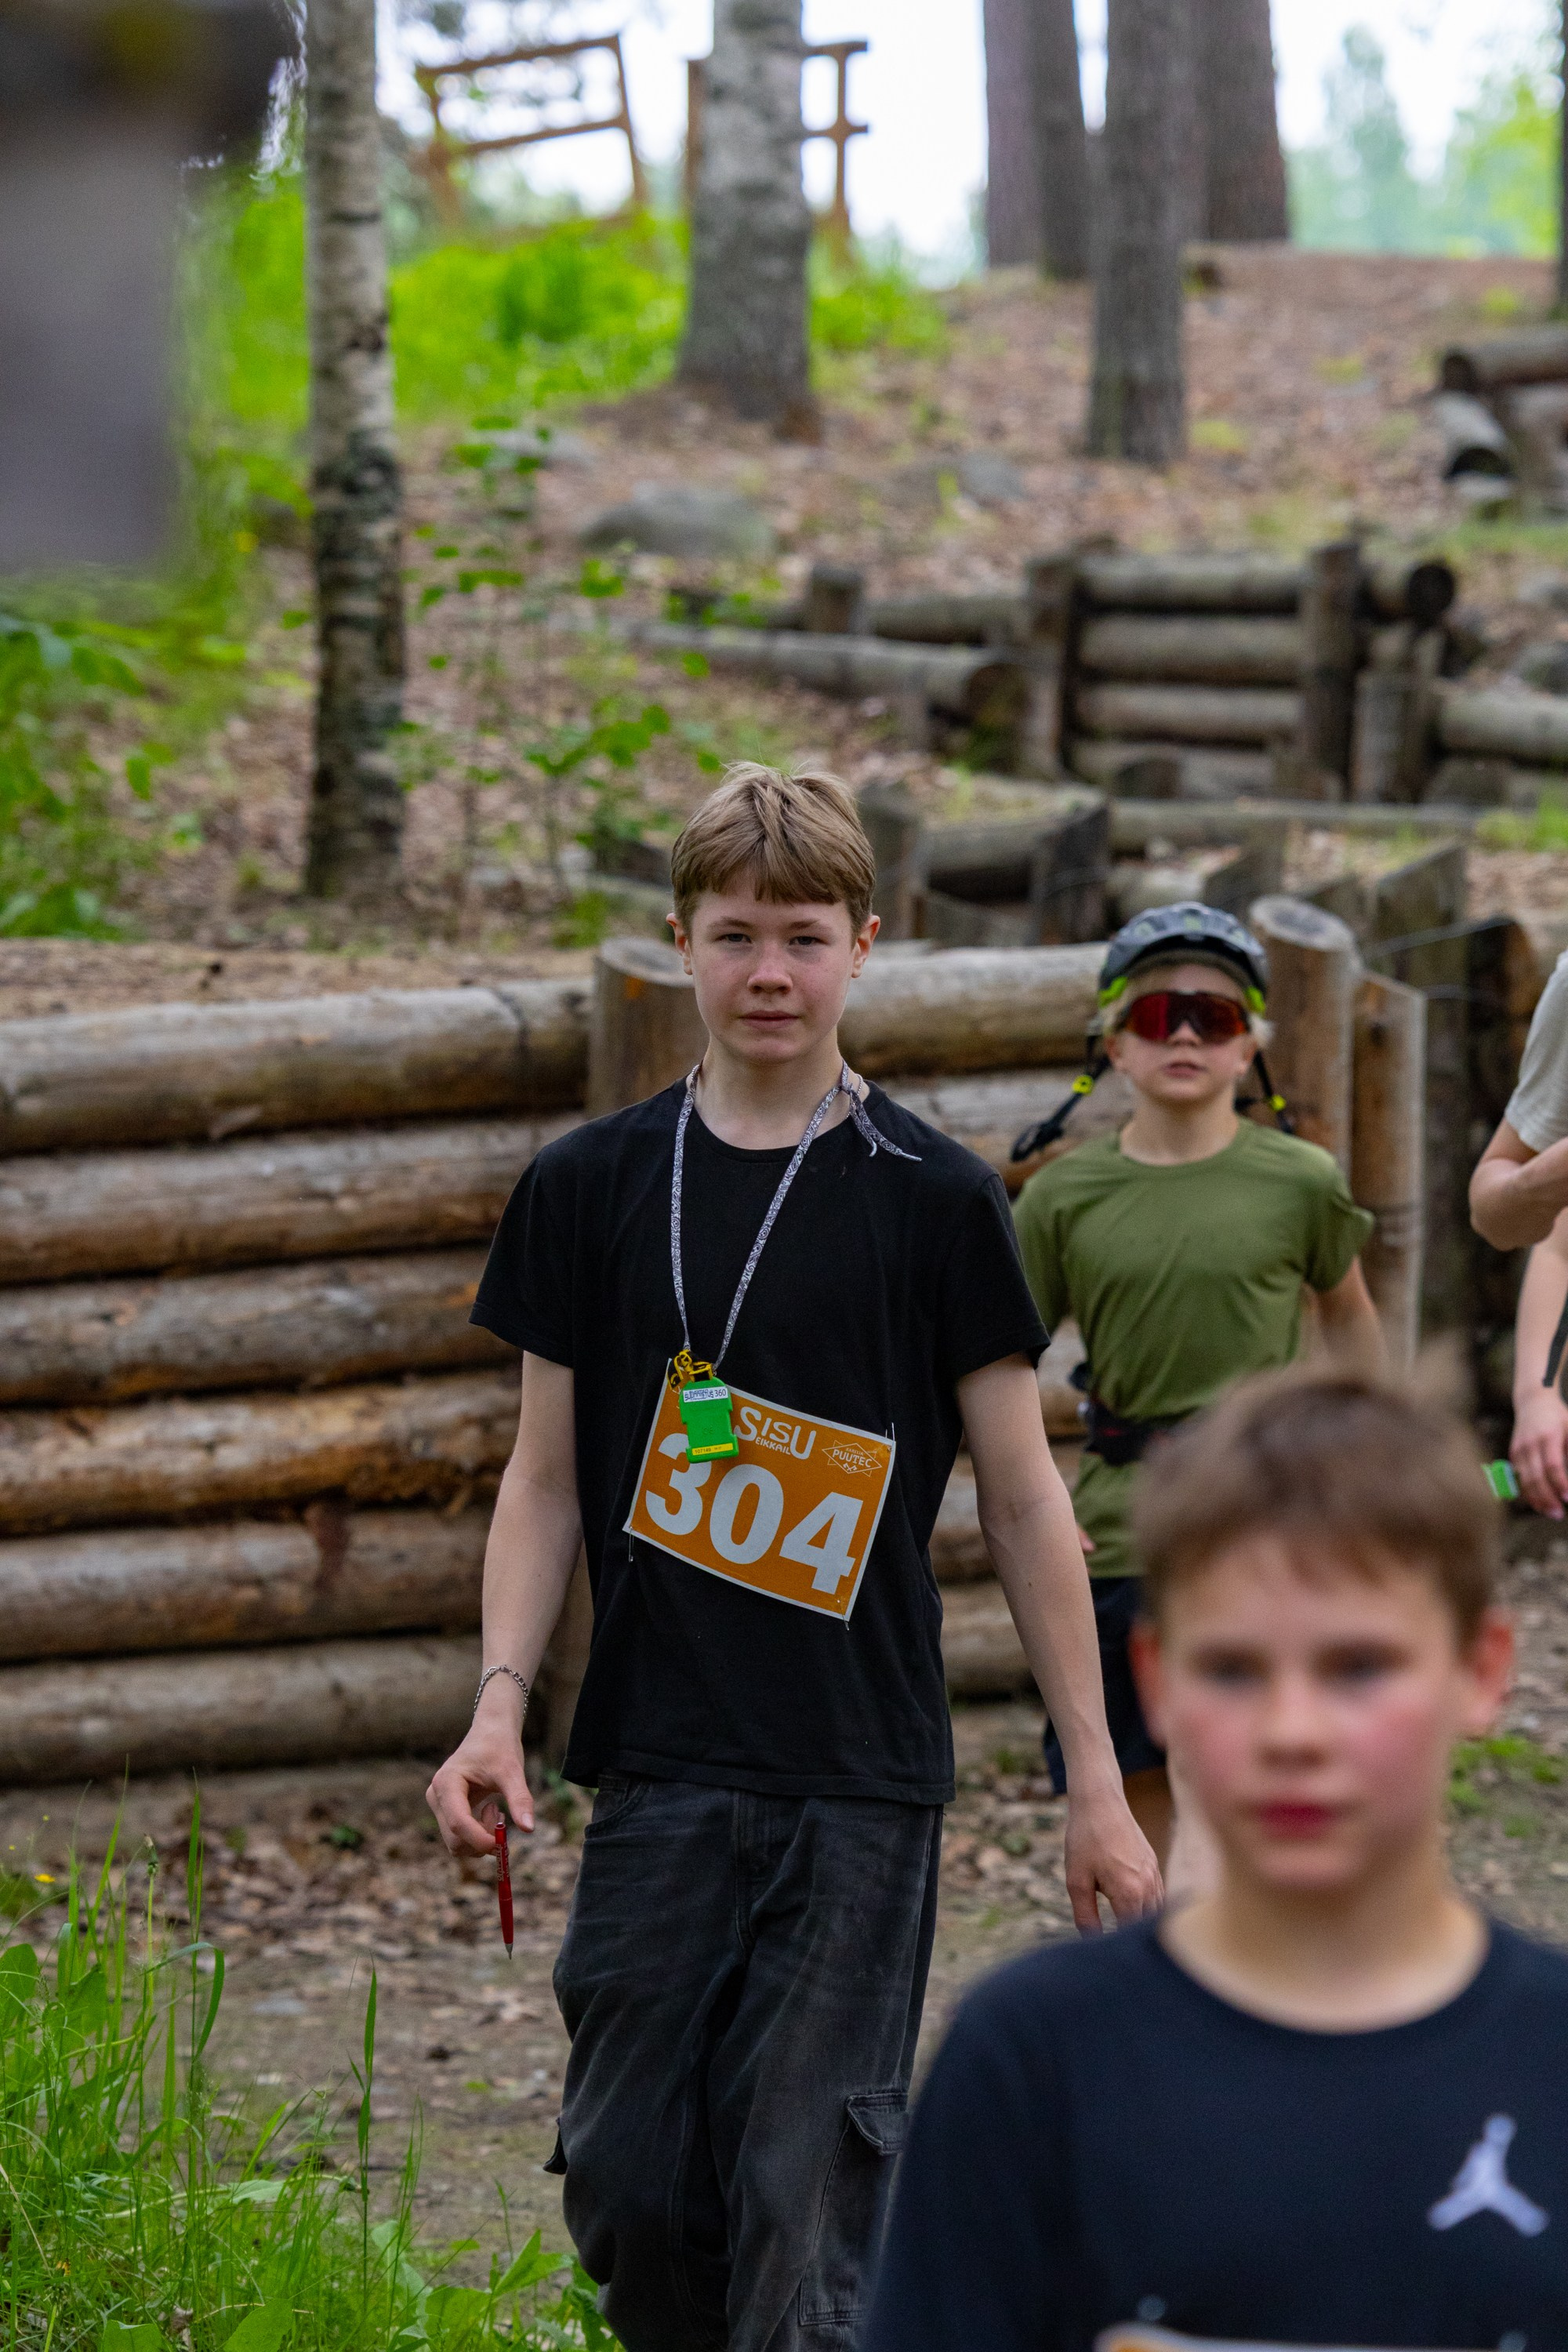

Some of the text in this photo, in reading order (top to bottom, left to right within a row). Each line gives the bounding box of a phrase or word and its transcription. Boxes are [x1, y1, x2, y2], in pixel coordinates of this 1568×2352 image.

[714, 1388, 727, 1397] 360
[733, 1406, 817, 1460] SISU
[832, 1449, 873, 1468] PUUTEC
[845, 1447, 864, 1456] KARELIA
[644, 1432, 865, 1596] 304
